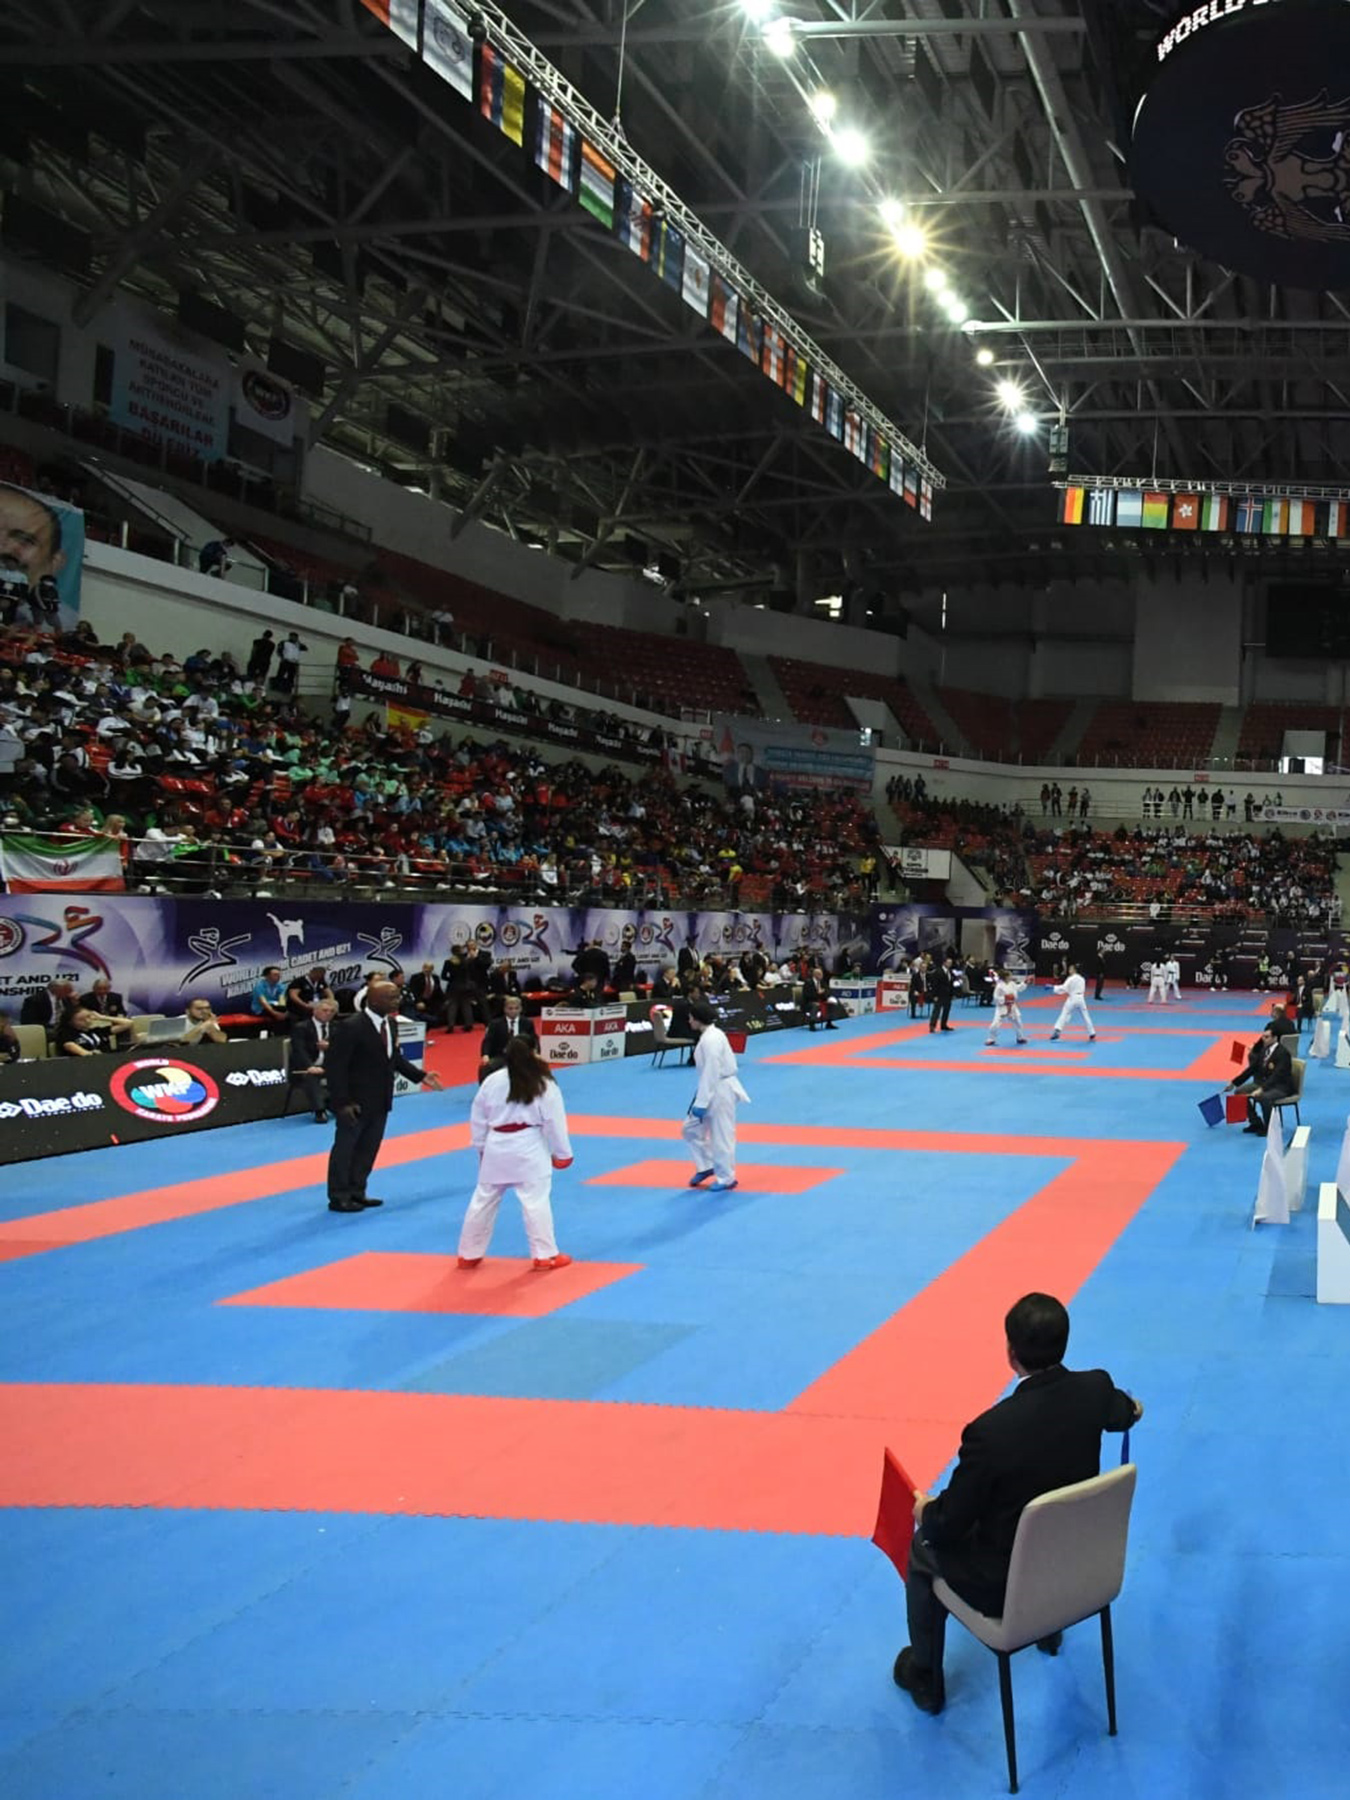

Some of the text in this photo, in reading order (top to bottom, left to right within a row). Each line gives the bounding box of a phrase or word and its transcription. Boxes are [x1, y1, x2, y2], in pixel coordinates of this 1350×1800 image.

[1157, 0, 1244, 61] WORLD
[17, 975, 51, 985] AND
[328, 964, 362, 987] 2022
[554, 1023, 576, 1034] AKA
[604, 1021, 618, 1032] AKA
